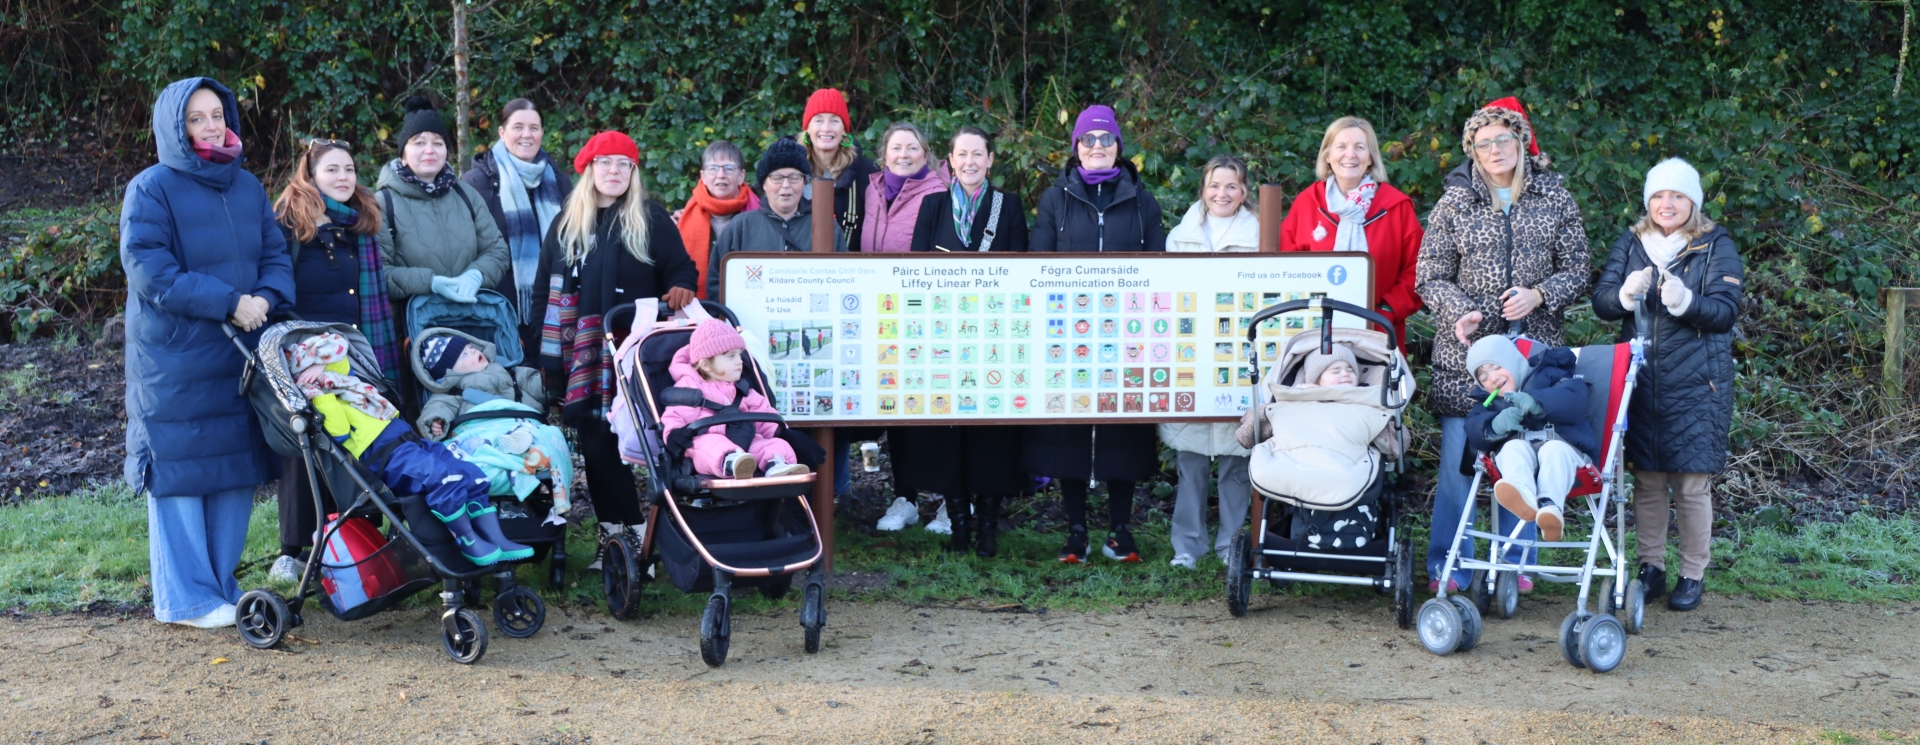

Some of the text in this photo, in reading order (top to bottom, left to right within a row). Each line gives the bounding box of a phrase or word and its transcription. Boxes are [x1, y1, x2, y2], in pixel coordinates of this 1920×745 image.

[769, 267, 875, 275] Comhairle Contae Chill Dara
[892, 266, 1009, 276] Páirc Lineach na Life
[1040, 265, 1139, 277] Fógra Cumarsáide
[1237, 271, 1256, 279] Find
[1282, 271, 1322, 279] Facebook
[797, 277, 824, 285] County
[901, 279, 1000, 290] Liffey Linear Park
[1029, 278, 1150, 288] Communication Board
